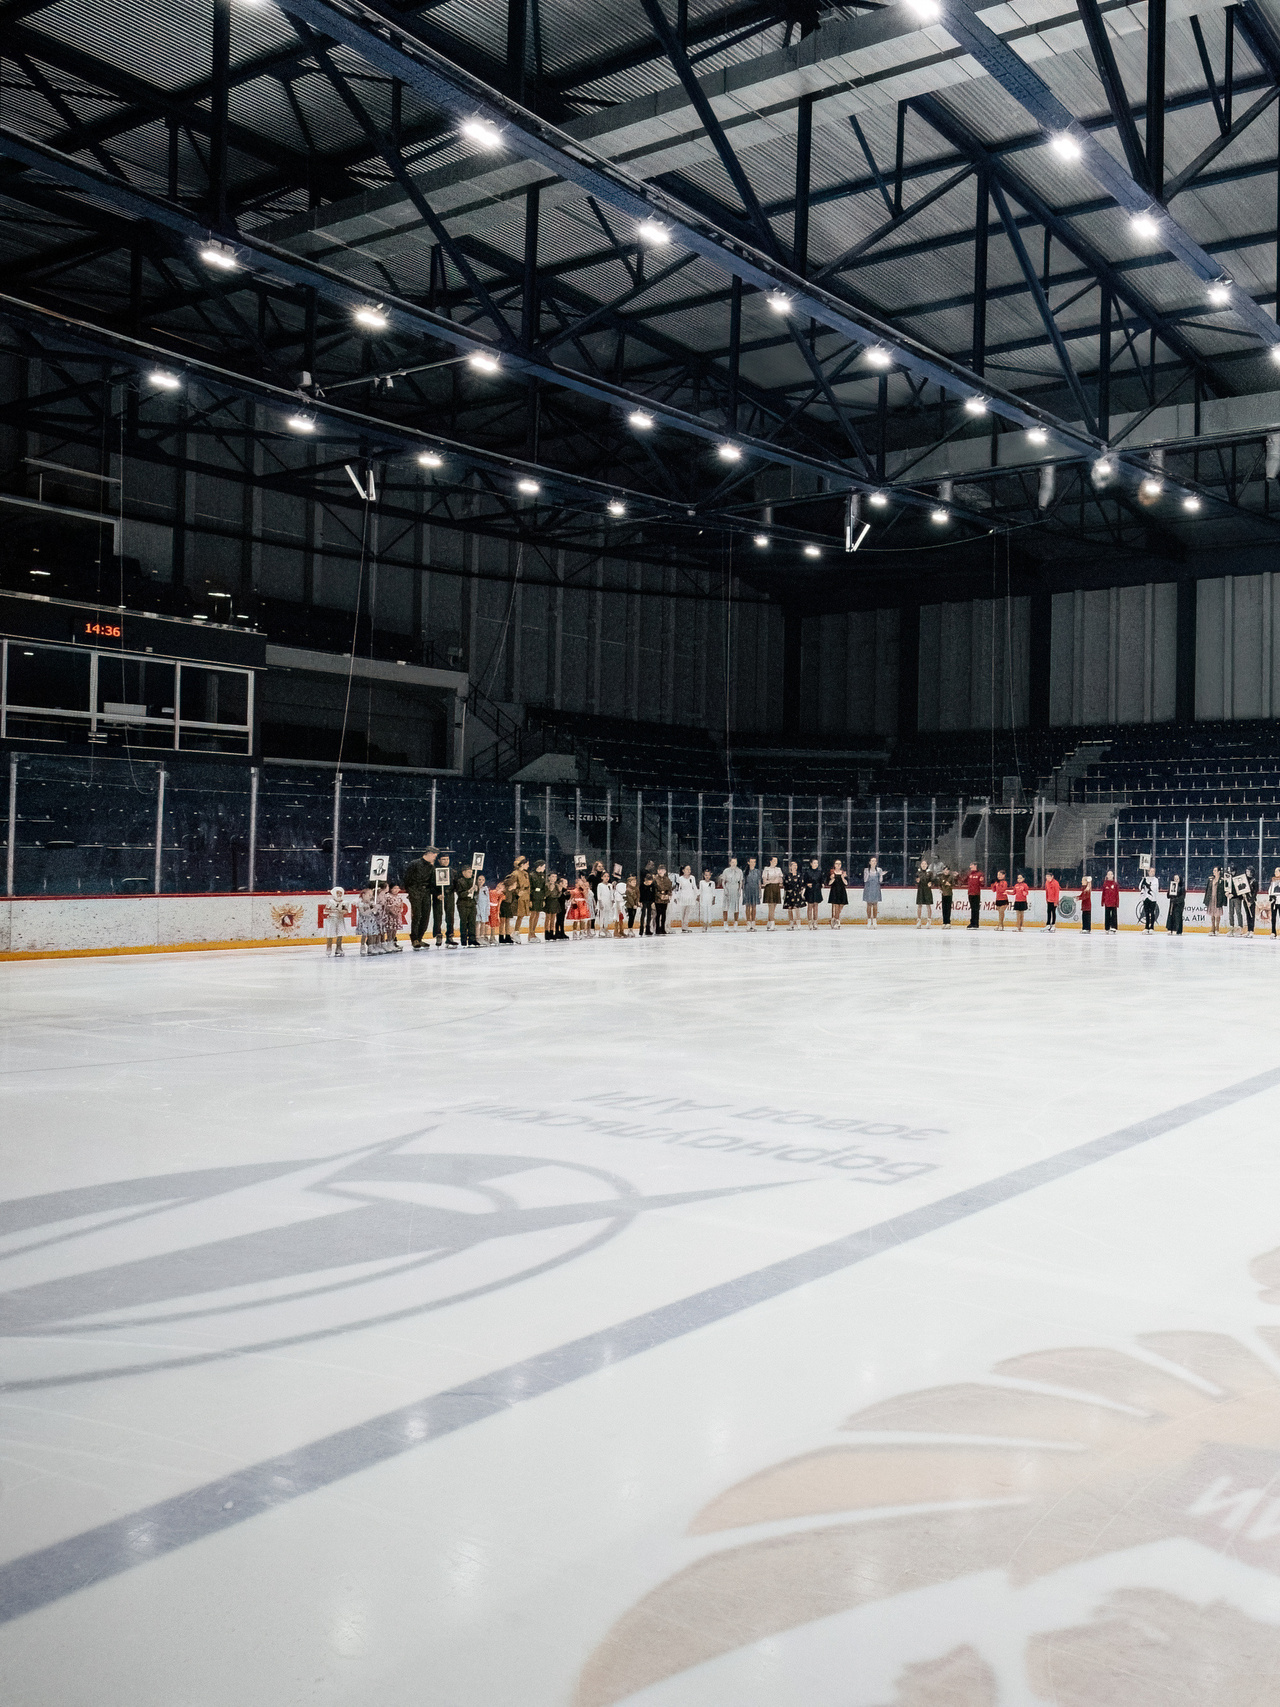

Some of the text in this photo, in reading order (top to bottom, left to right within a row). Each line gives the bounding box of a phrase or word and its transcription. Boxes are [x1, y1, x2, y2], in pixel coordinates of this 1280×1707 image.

[85, 623, 121, 637] 14:36
[1192, 914, 1205, 922] АТИ
[571, 1090, 948, 1142] завод АТИ
[427, 1101, 943, 1186] Барнаульский
